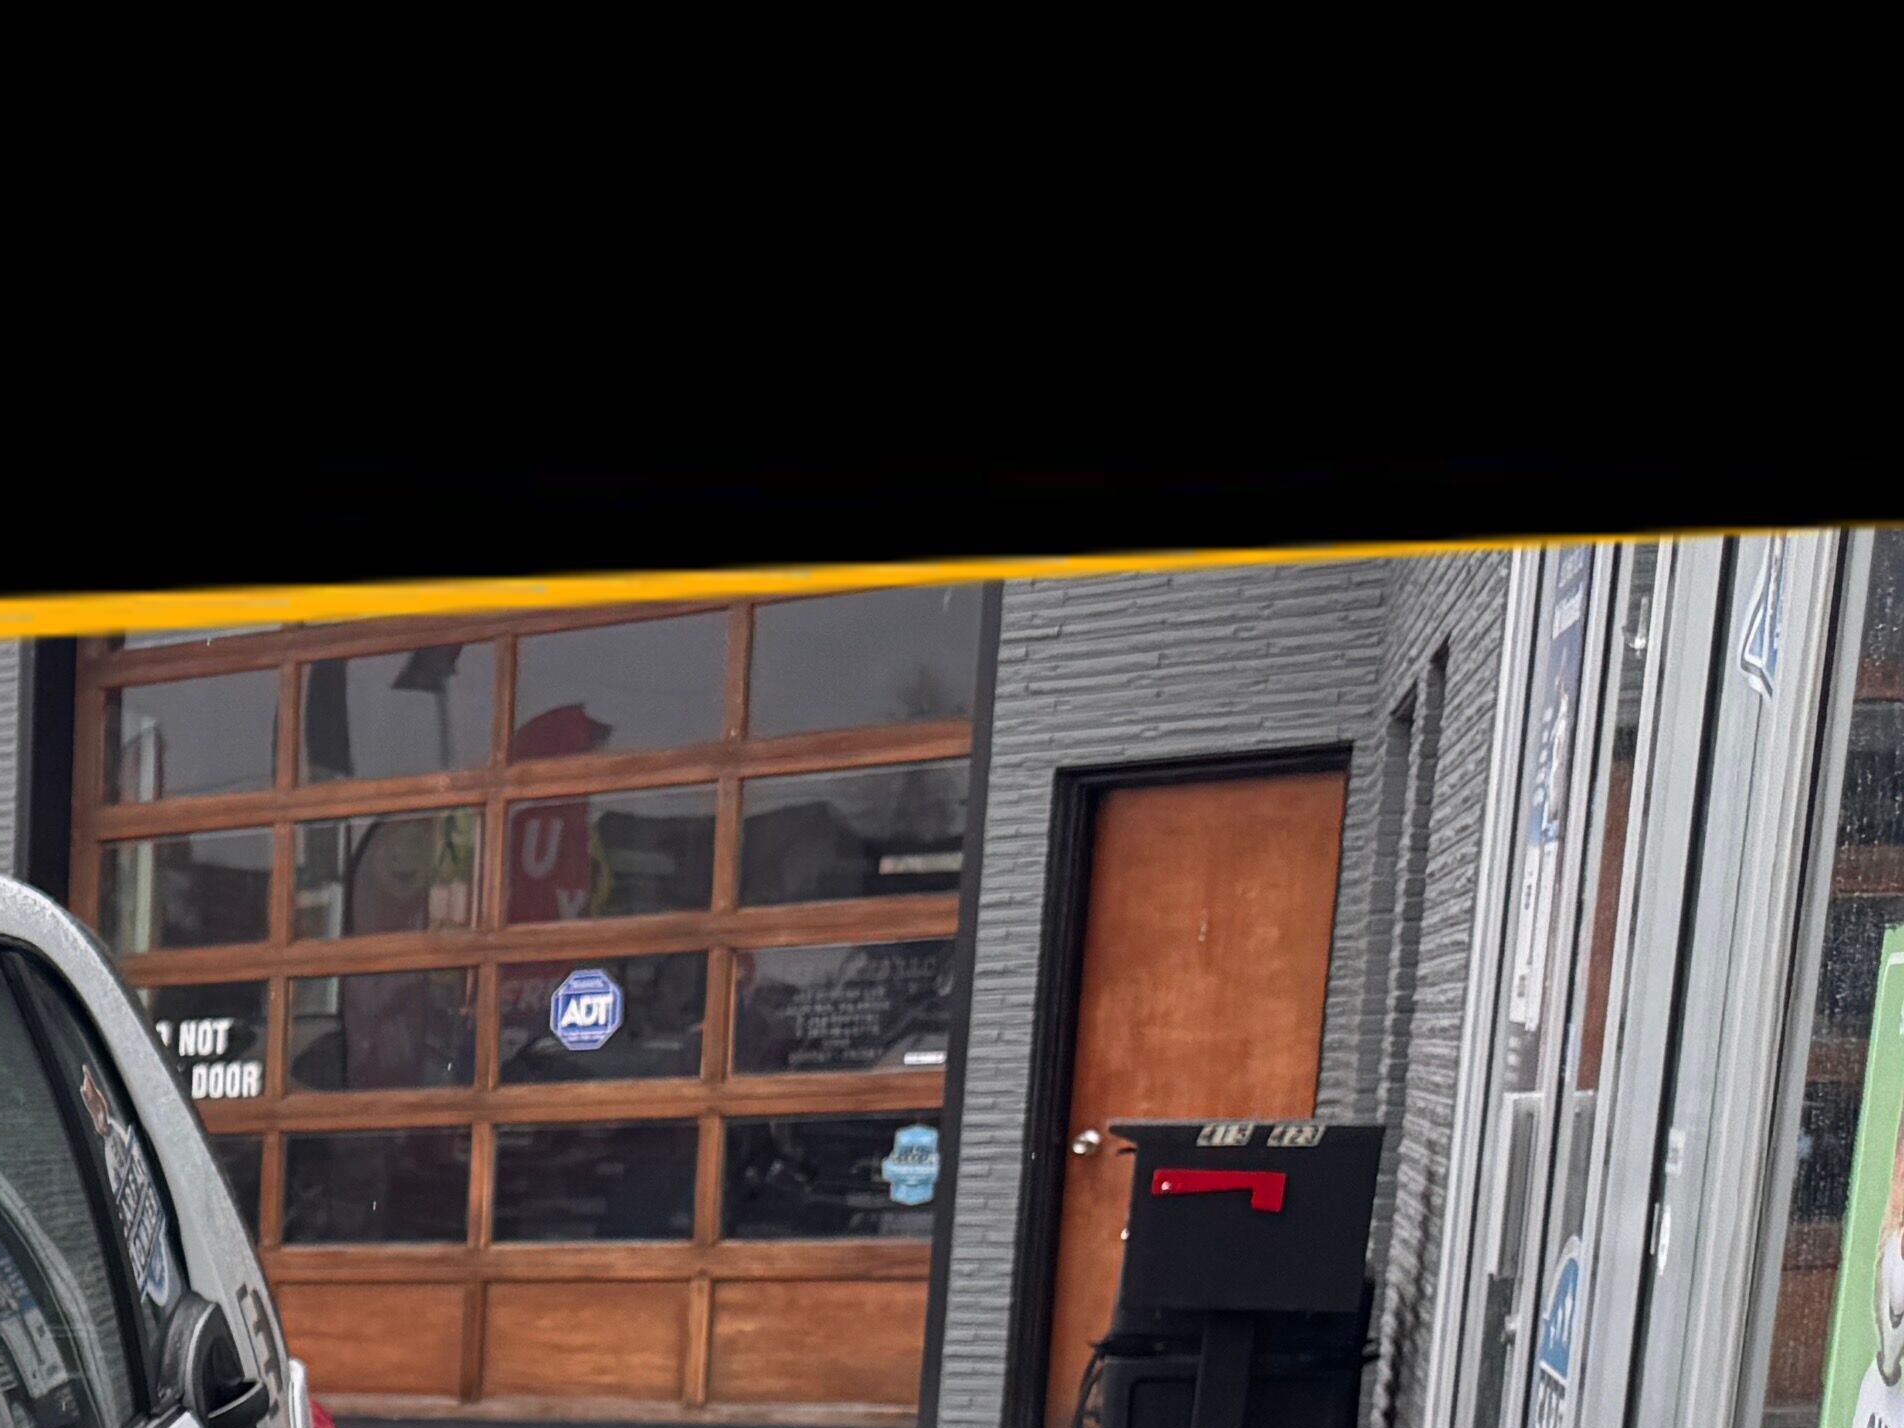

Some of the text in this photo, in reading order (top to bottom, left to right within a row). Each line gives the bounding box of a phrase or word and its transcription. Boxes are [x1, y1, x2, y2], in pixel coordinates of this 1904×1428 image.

[561, 994, 613, 1028] ADT
[178, 1017, 235, 1056] NOT
[191, 1061, 263, 1099] DOOR
